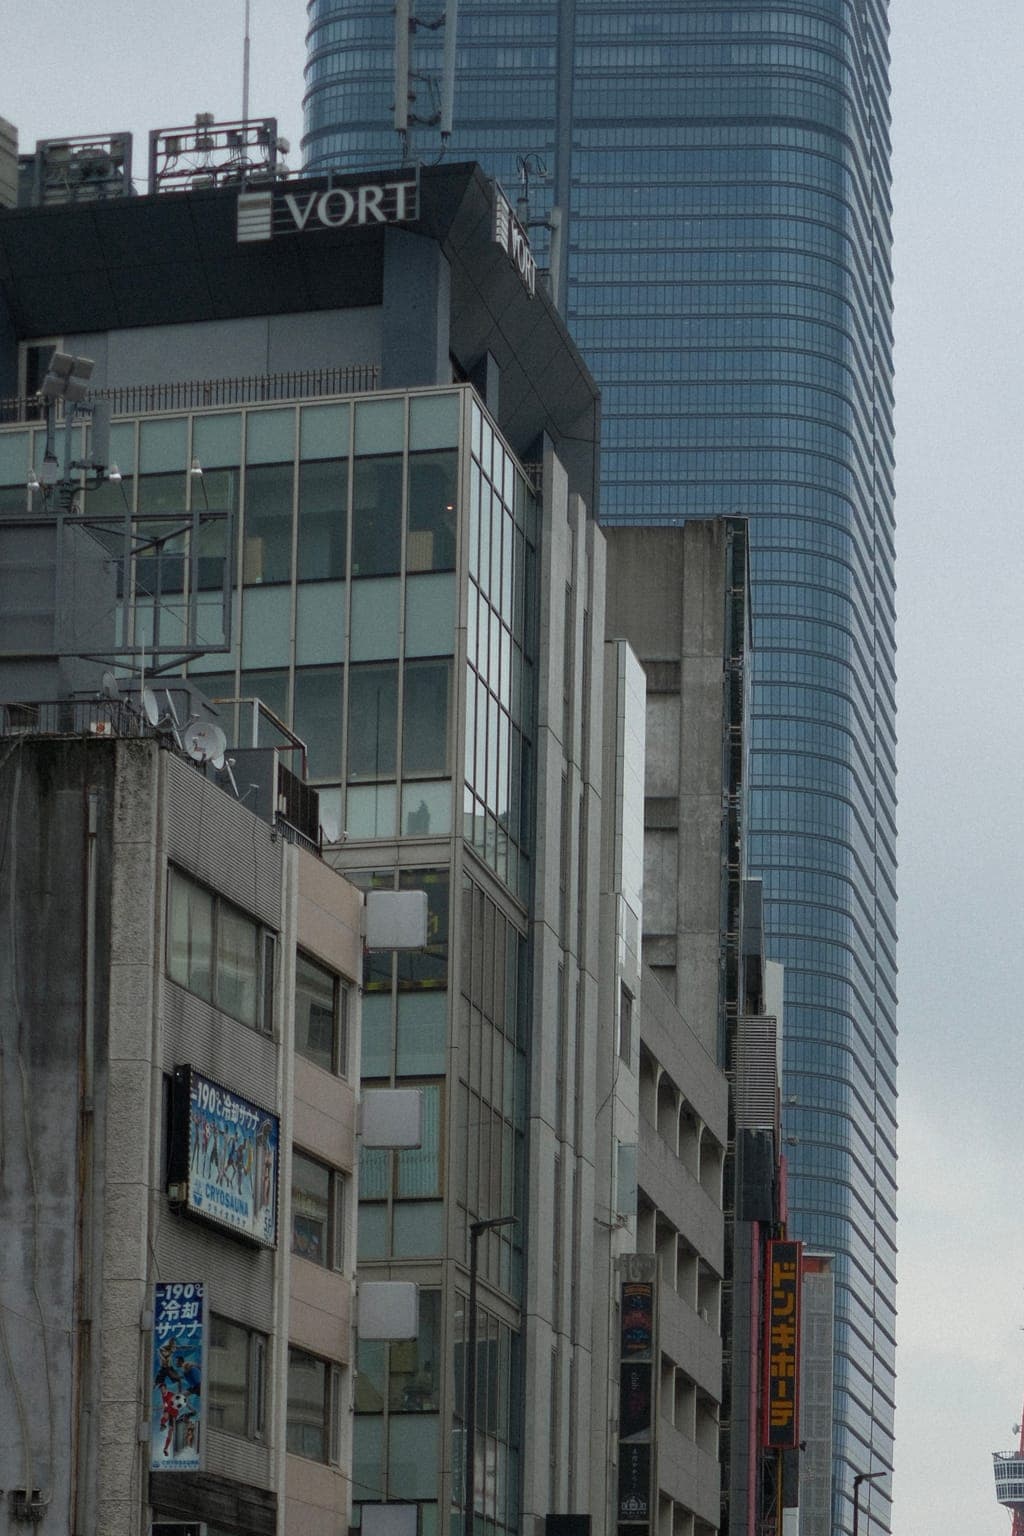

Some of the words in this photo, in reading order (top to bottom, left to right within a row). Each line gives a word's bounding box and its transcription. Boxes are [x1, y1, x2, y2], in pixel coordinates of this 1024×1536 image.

[284, 181, 417, 231] VORT
[511, 218, 537, 299] VORT
[205, 1182, 249, 1217] CRYOSAUNA
[159, 1300, 199, 1321] 冷却
[156, 1320, 203, 1339] サウナ
